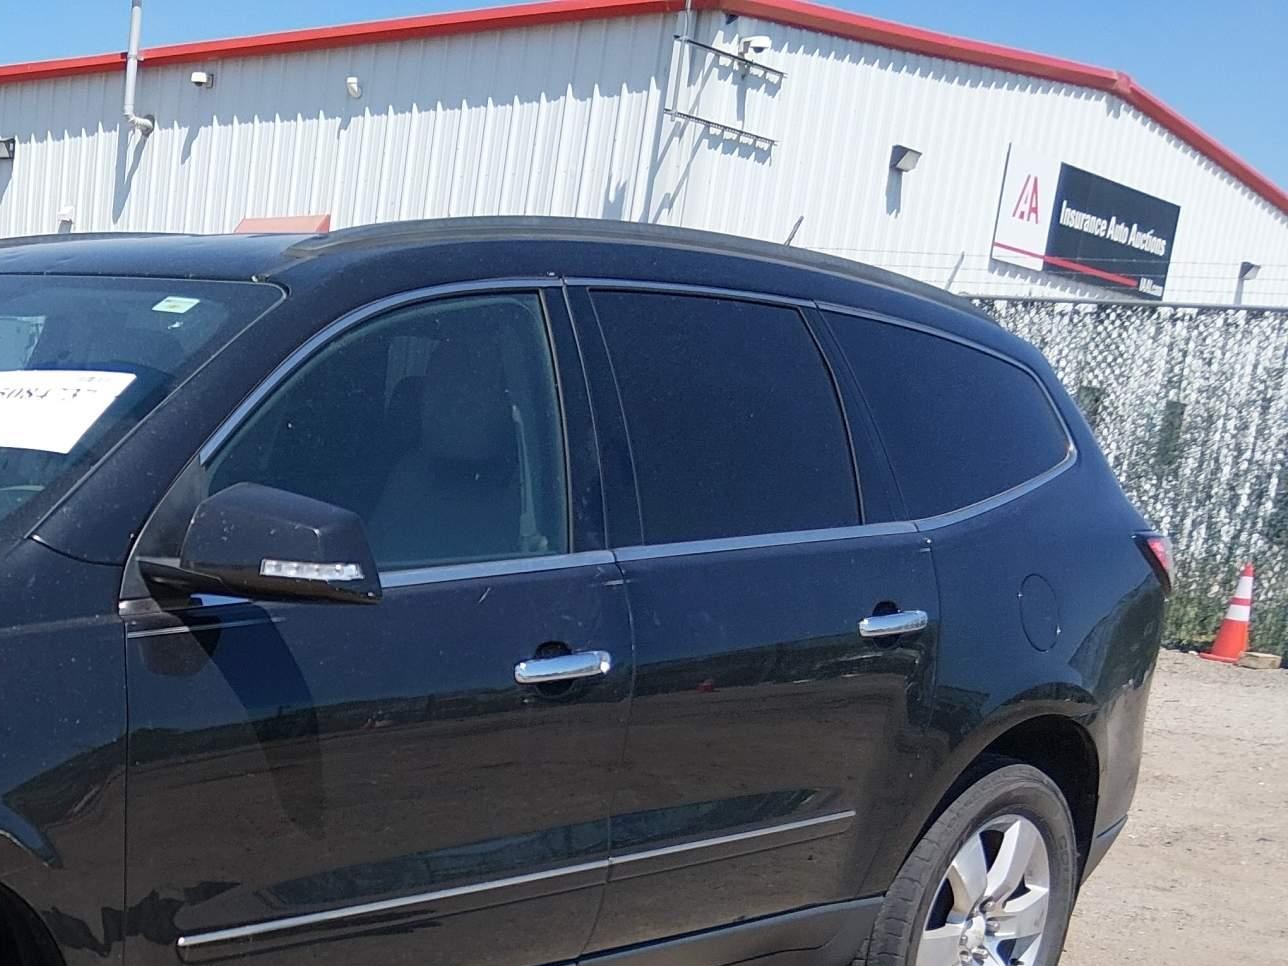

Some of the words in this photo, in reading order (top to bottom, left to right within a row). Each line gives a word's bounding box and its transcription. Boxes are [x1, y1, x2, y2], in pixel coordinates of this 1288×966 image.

[1060, 200, 1107, 237] Insurance
[1107, 216, 1129, 245] Auto
[1128, 223, 1166, 256] Auctions
